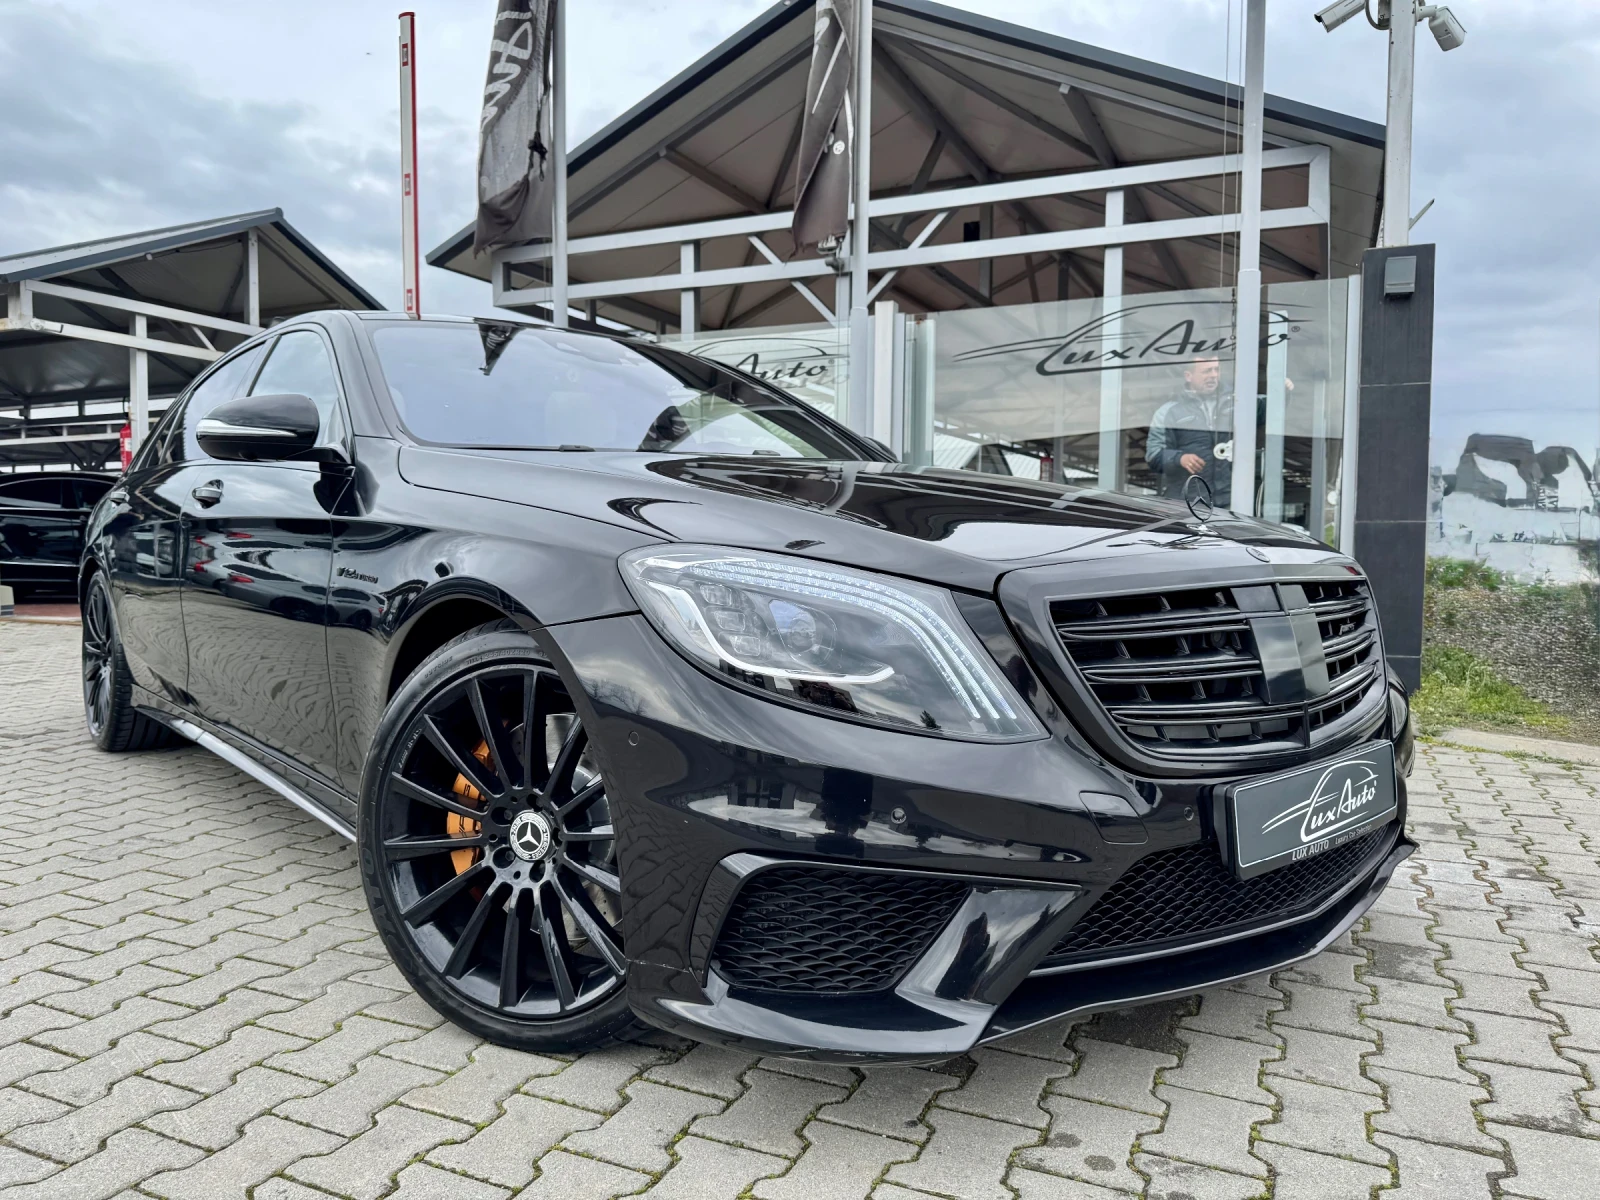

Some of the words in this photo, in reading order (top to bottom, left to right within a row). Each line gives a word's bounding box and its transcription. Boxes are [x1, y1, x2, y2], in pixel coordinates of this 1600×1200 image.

[1138, 319, 1291, 358] Auo
[1337, 778, 1376, 820] Auto
[1291, 845, 1307, 861] LUX
[1308, 840, 1330, 856] AUTO
